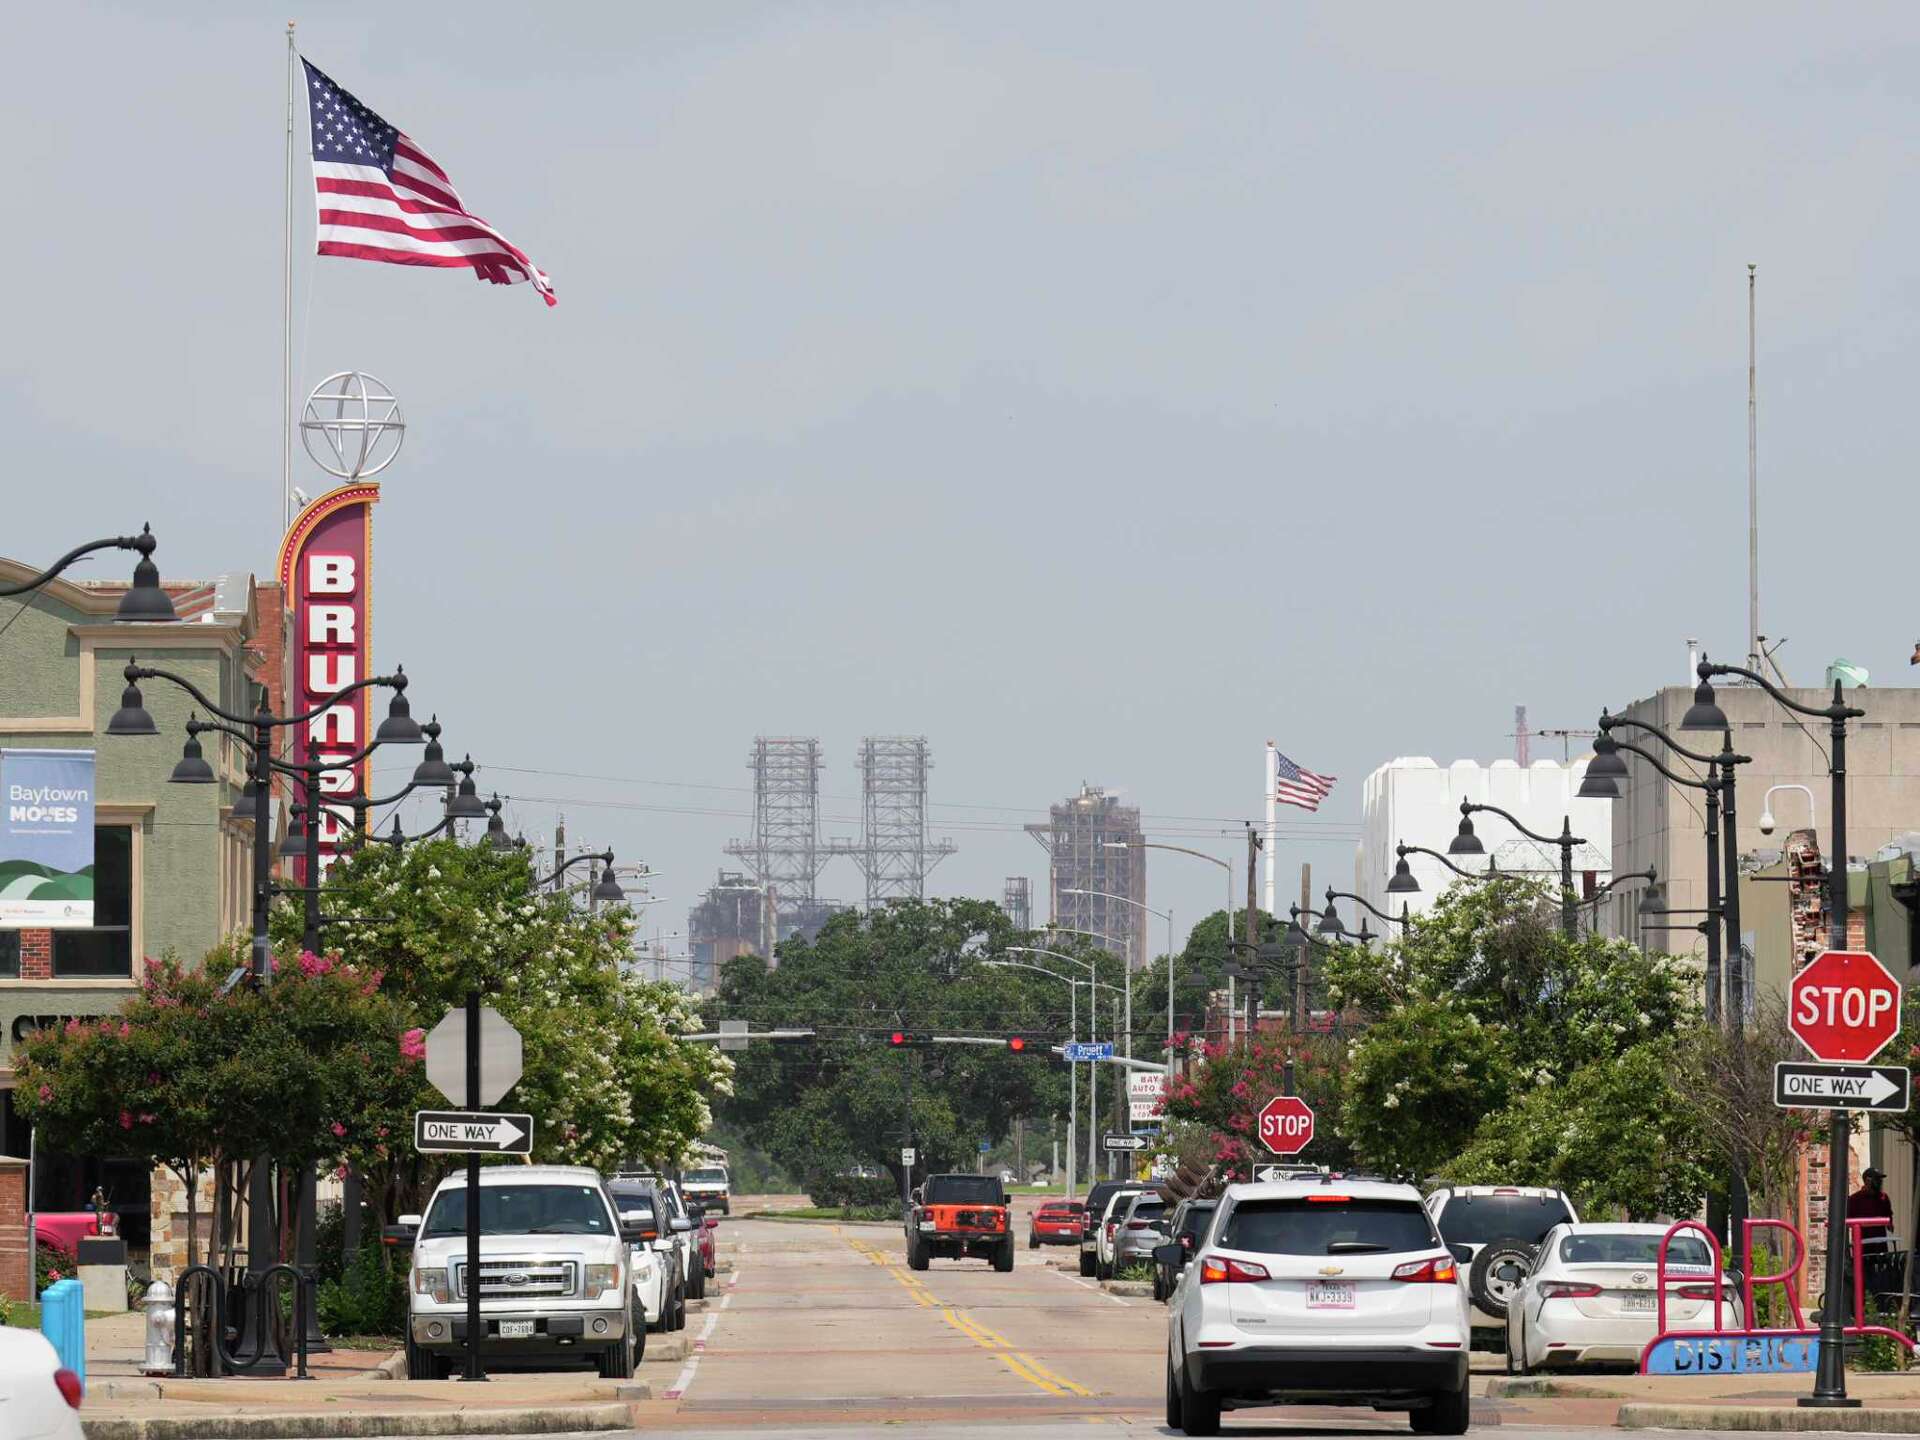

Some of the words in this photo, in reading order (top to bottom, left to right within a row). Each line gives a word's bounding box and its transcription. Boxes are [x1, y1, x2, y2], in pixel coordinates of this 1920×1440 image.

[10, 785, 89, 805] Baytown
[1797, 985, 1892, 1027] STOP
[1078, 1045, 1103, 1056] Pruett
[1789, 1077, 1823, 1093] ONE
[1831, 1079, 1866, 1095] WAY
[428, 1124, 458, 1138] ONE
[464, 1126, 496, 1139] WAY
[1263, 1115, 1310, 1136] STOP
[1272, 1172, 1290, 1180] ONE
[1673, 1339, 1812, 1371] DISTRICT
